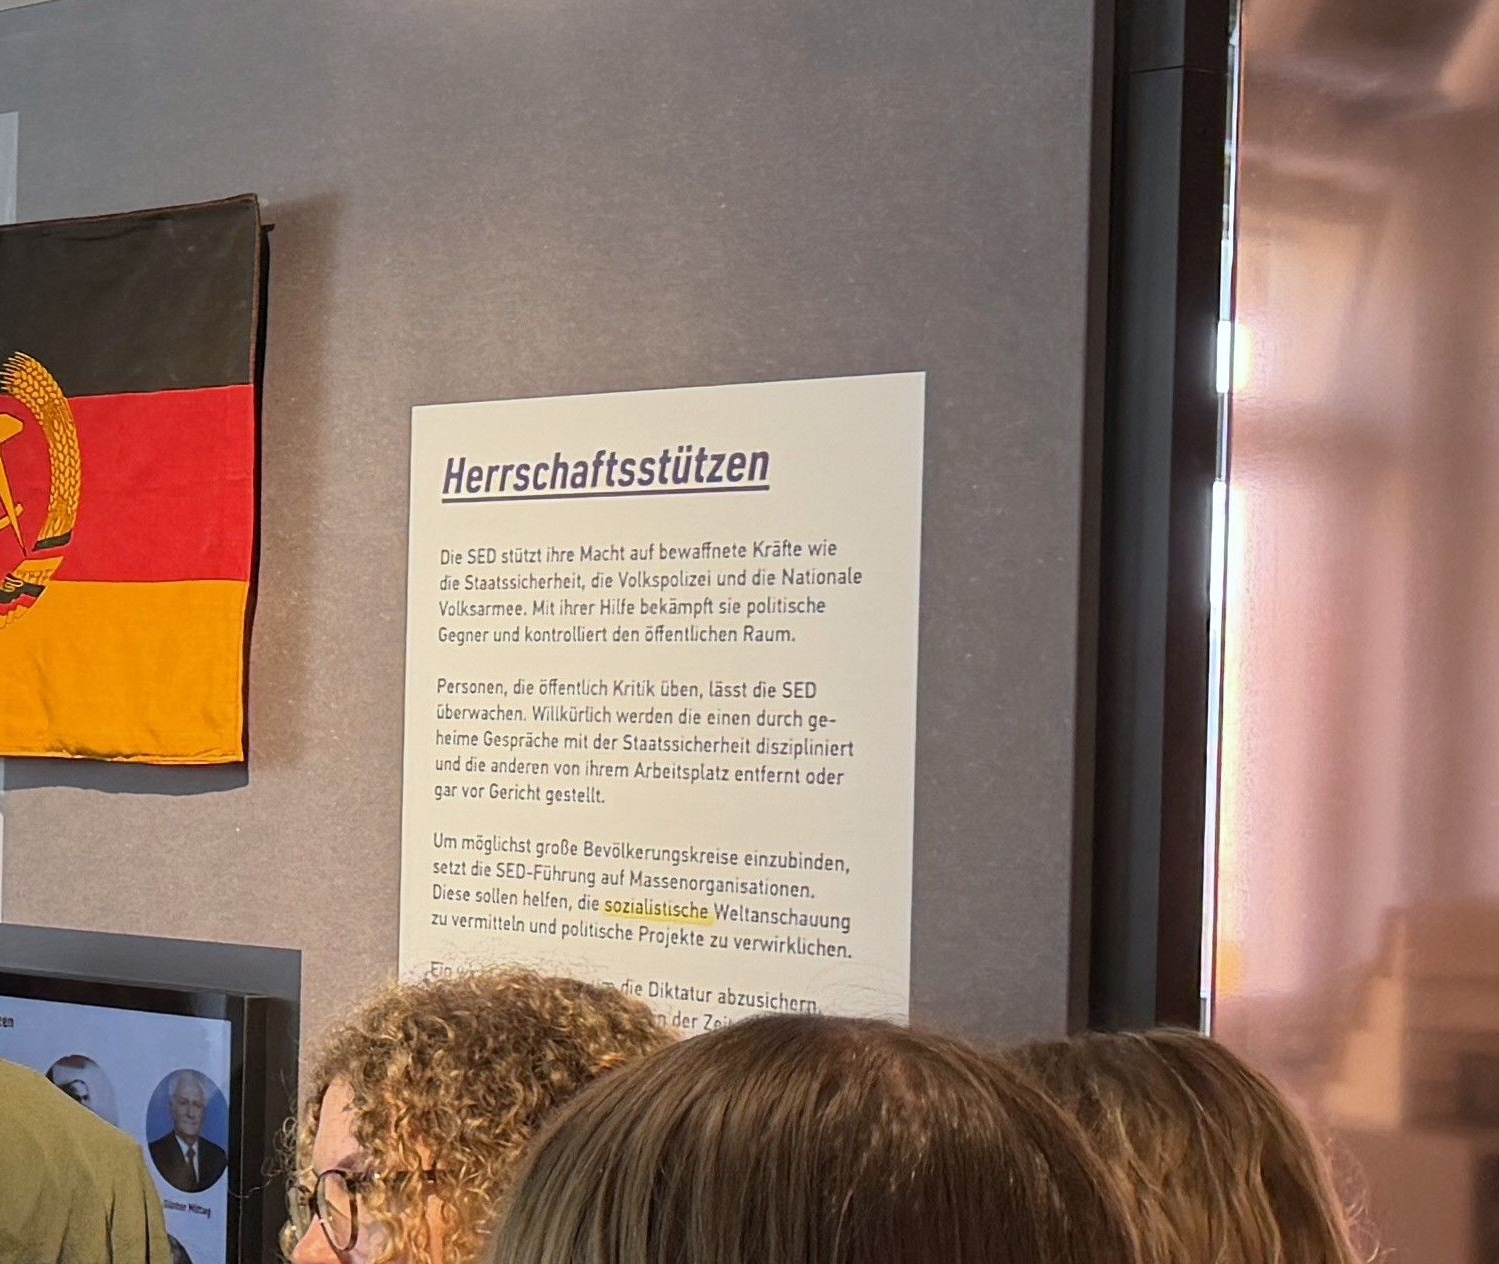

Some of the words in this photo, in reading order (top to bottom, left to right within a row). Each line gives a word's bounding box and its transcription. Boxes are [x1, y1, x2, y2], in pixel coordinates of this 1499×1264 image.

[441, 444, 771, 496] Herrschaftsstützen
[441, 549, 462, 566] Die
[468, 547, 496, 565] SED
[501, 547, 541, 564] stützt
[546, 546, 574, 563] ihre
[580, 544, 624, 562] Macht
[630, 542, 654, 561] auf
[659, 541, 747, 560] bewaffnete
[753, 539, 802, 558] Kräfte
[808, 538, 837, 557] wie
[440, 574, 460, 591] die
[465, 572, 585, 591] Staatssicherheit,
[591, 571, 613, 589] die
[619, 569, 711, 592] Volkspolizei
[717, 569, 746, 587] und
[752, 567, 776, 586] die
[782, 566, 862, 586] Nationale
[439, 599, 527, 617] Volksarmee.
[533, 599, 555, 616] Mit
[560, 598, 595, 616] ihrer
[600, 597, 635, 616] Hilfe
[640, 596, 713, 619] bekämpft
[719, 597, 741, 615] sie
[747, 595, 826, 619] politische
[438, 626, 489, 647] Gegner
[494, 625, 519, 643] und
[525, 625, 607, 643] kontrolliert
[613, 625, 639, 643] den
[645, 624, 737, 643] öffentlichen
[743, 624, 795, 642] Raum.
[437, 677, 507, 698] Personen,
[514, 678, 534, 696] die
[539, 678, 607, 696] öffentlich
[613, 679, 655, 697] Kritik
[661, 679, 703, 700] üben,
[709, 680, 747, 699] lässt
[753, 680, 776, 699] die
[782, 681, 817, 699] SED
[437, 703, 526, 722] überwachen.
[533, 705, 611, 724] Willkürlich
[616, 707, 673, 725] werden
[679, 707, 701, 725] die
[707, 708, 750, 727] einen
[757, 708, 802, 728] durch
[808, 714, 836, 733] ge-
[436, 729, 478, 747] heime
[484, 730, 558, 752] Gespräche
[564, 733, 588, 750] mit
[593, 732, 618, 751] der
[623, 733, 750, 754] Staatssicherheit
[756, 736, 853, 760] diszipliniert
[436, 755, 460, 772] und
[465, 755, 486, 773] die
[491, 757, 548, 775] anderen
[554, 763, 580, 776] von
[585, 759, 629, 778] ihrem
[634, 761, 729, 785] Arbeitsplatz
[735, 764, 800, 784] entfernt
[806, 766, 844, 786] oder
[435, 785, 457, 803] gar
[462, 786, 485, 799] vor
[490, 783, 540, 801] Gericht
[546, 786, 605, 806] gestellt.
[434, 832, 457, 850] Um
[462, 834, 531, 856] möglichst
[536, 838, 577, 859] große
[584, 840, 738, 867] Bevölkerungskreise
[744, 849, 849, 875] einzubinden,
[433, 860, 466, 876] setzt
[471, 860, 491, 878] die
[496, 861, 595, 889] SED-Führung
[601, 868, 624, 886] auf
[630, 869, 815, 899] Massenorganisationen.
[433, 883, 470, 902] Diese
[476, 887, 517, 906] sollen
[523, 889, 572, 912] helfen,
[578, 893, 599, 912] die
[605, 898, 708, 920] sozialistische
[714, 902, 850, 935] Weltanschauung
[431, 913, 447, 926] zu
[452, 914, 524, 933] vermitteln
[530, 918, 556, 935] und
[562, 920, 633, 941] politische
[639, 925, 704, 949] Projekte
[710, 935, 728, 949] zu
[734, 935, 852, 959] verwirklichen.
[621, 979, 643, 997] die
[648, 980, 713, 1004] Diktatur
[672, 1010, 697, 1030] der
